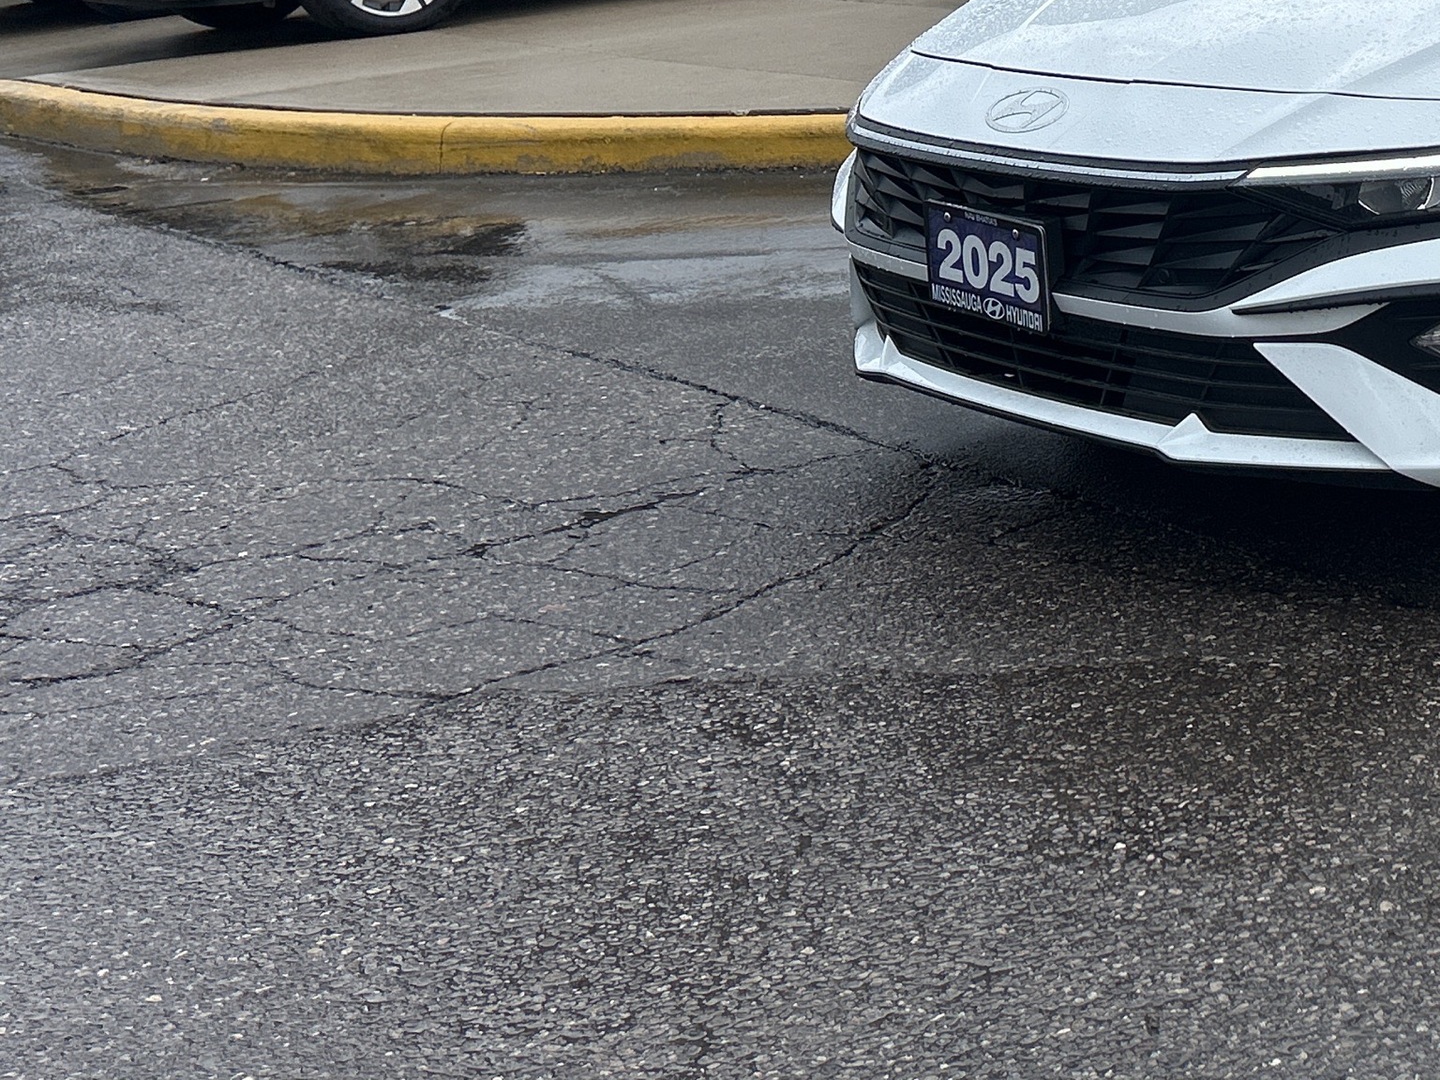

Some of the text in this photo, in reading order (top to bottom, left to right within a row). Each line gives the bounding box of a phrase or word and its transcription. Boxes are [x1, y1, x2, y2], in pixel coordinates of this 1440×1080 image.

[937, 228, 1040, 304] 2025
[931, 283, 1043, 332] MISSISSAUGA HYUNDAI
